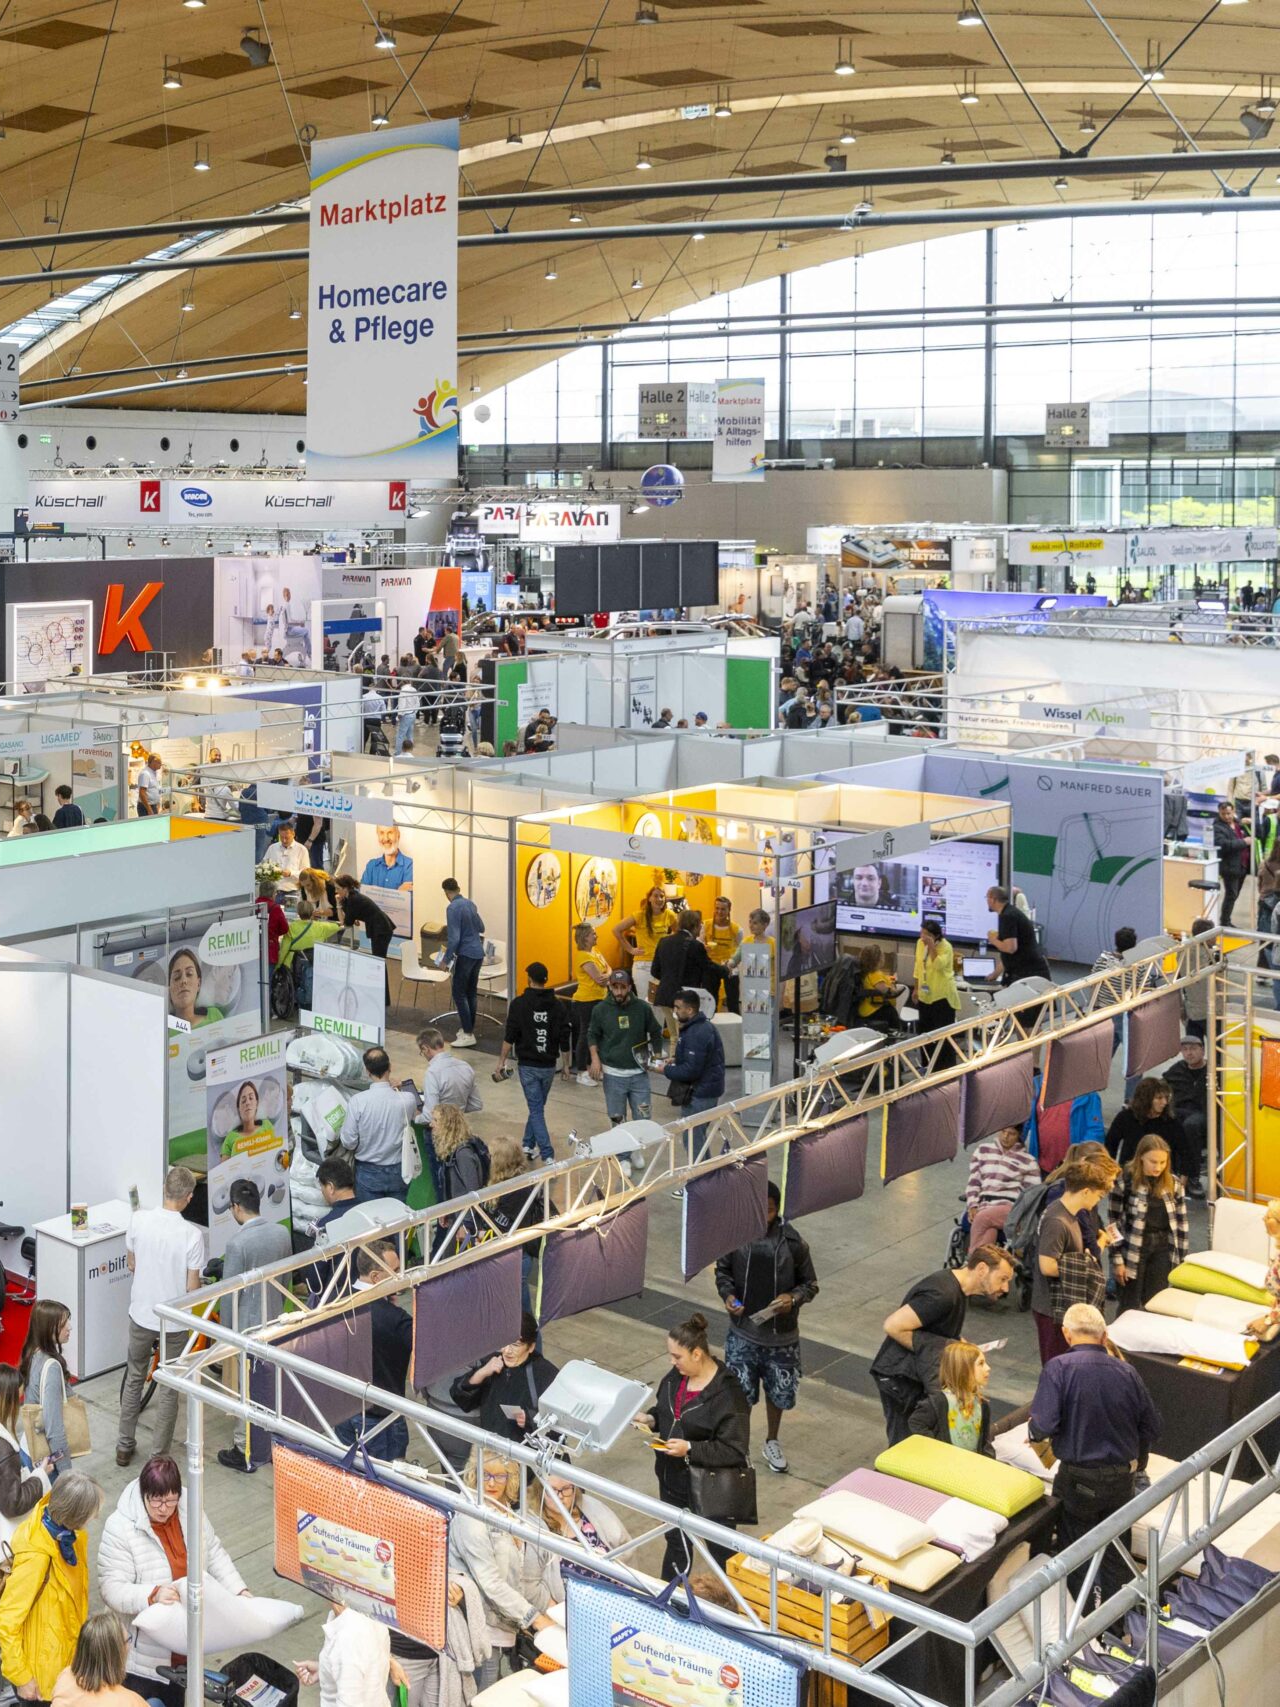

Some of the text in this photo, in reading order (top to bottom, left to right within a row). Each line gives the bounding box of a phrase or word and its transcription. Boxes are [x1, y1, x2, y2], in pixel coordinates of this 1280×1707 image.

[320, 193, 447, 227] Marktplatz
[318, 280, 447, 310] Homecare
[329, 316, 434, 345] & Pflege
[7, 353, 16, 371] 2
[640, 390, 685, 404] Halle 2
[689, 390, 710, 403] Halle
[718, 397, 762, 406] Marktplatz
[1047, 408, 1088, 419] Halle 2
[718, 416, 762, 426] Mobilität
[726, 427, 761, 437] Alltags-
[726, 437, 752, 446] hilfen
[35, 495, 105, 508] Küschall
[265, 495, 333, 508] Küschall
[484, 507, 519, 520] PARA
[526, 511, 609, 527] PARAVAN
[1068, 540, 1102, 549] Rollator
[342, 574, 371, 584] PARAVAN
[380, 577, 412, 587] PARAVAN
[97, 582, 165, 656] K
[958, 715, 979, 723] Natur
[1043, 707, 1125, 726] Wissel Alpin
[41, 732, 80, 745] LIGAMED
[1060, 780, 1152, 797] MANFRED SAUER
[294, 788, 353, 812] UROMED
[208, 929, 251, 951] REMILI
[175, 1020, 189, 1032] A44
[313, 1015, 362, 1041] REMILI
[239, 1039, 281, 1064] REMILI
[312, 1525, 344, 1545] Duftende
[345, 1539, 371, 1554] Träume
[633, 1640, 676, 1666] Duftende
[677, 1656, 713, 1678] Träume
